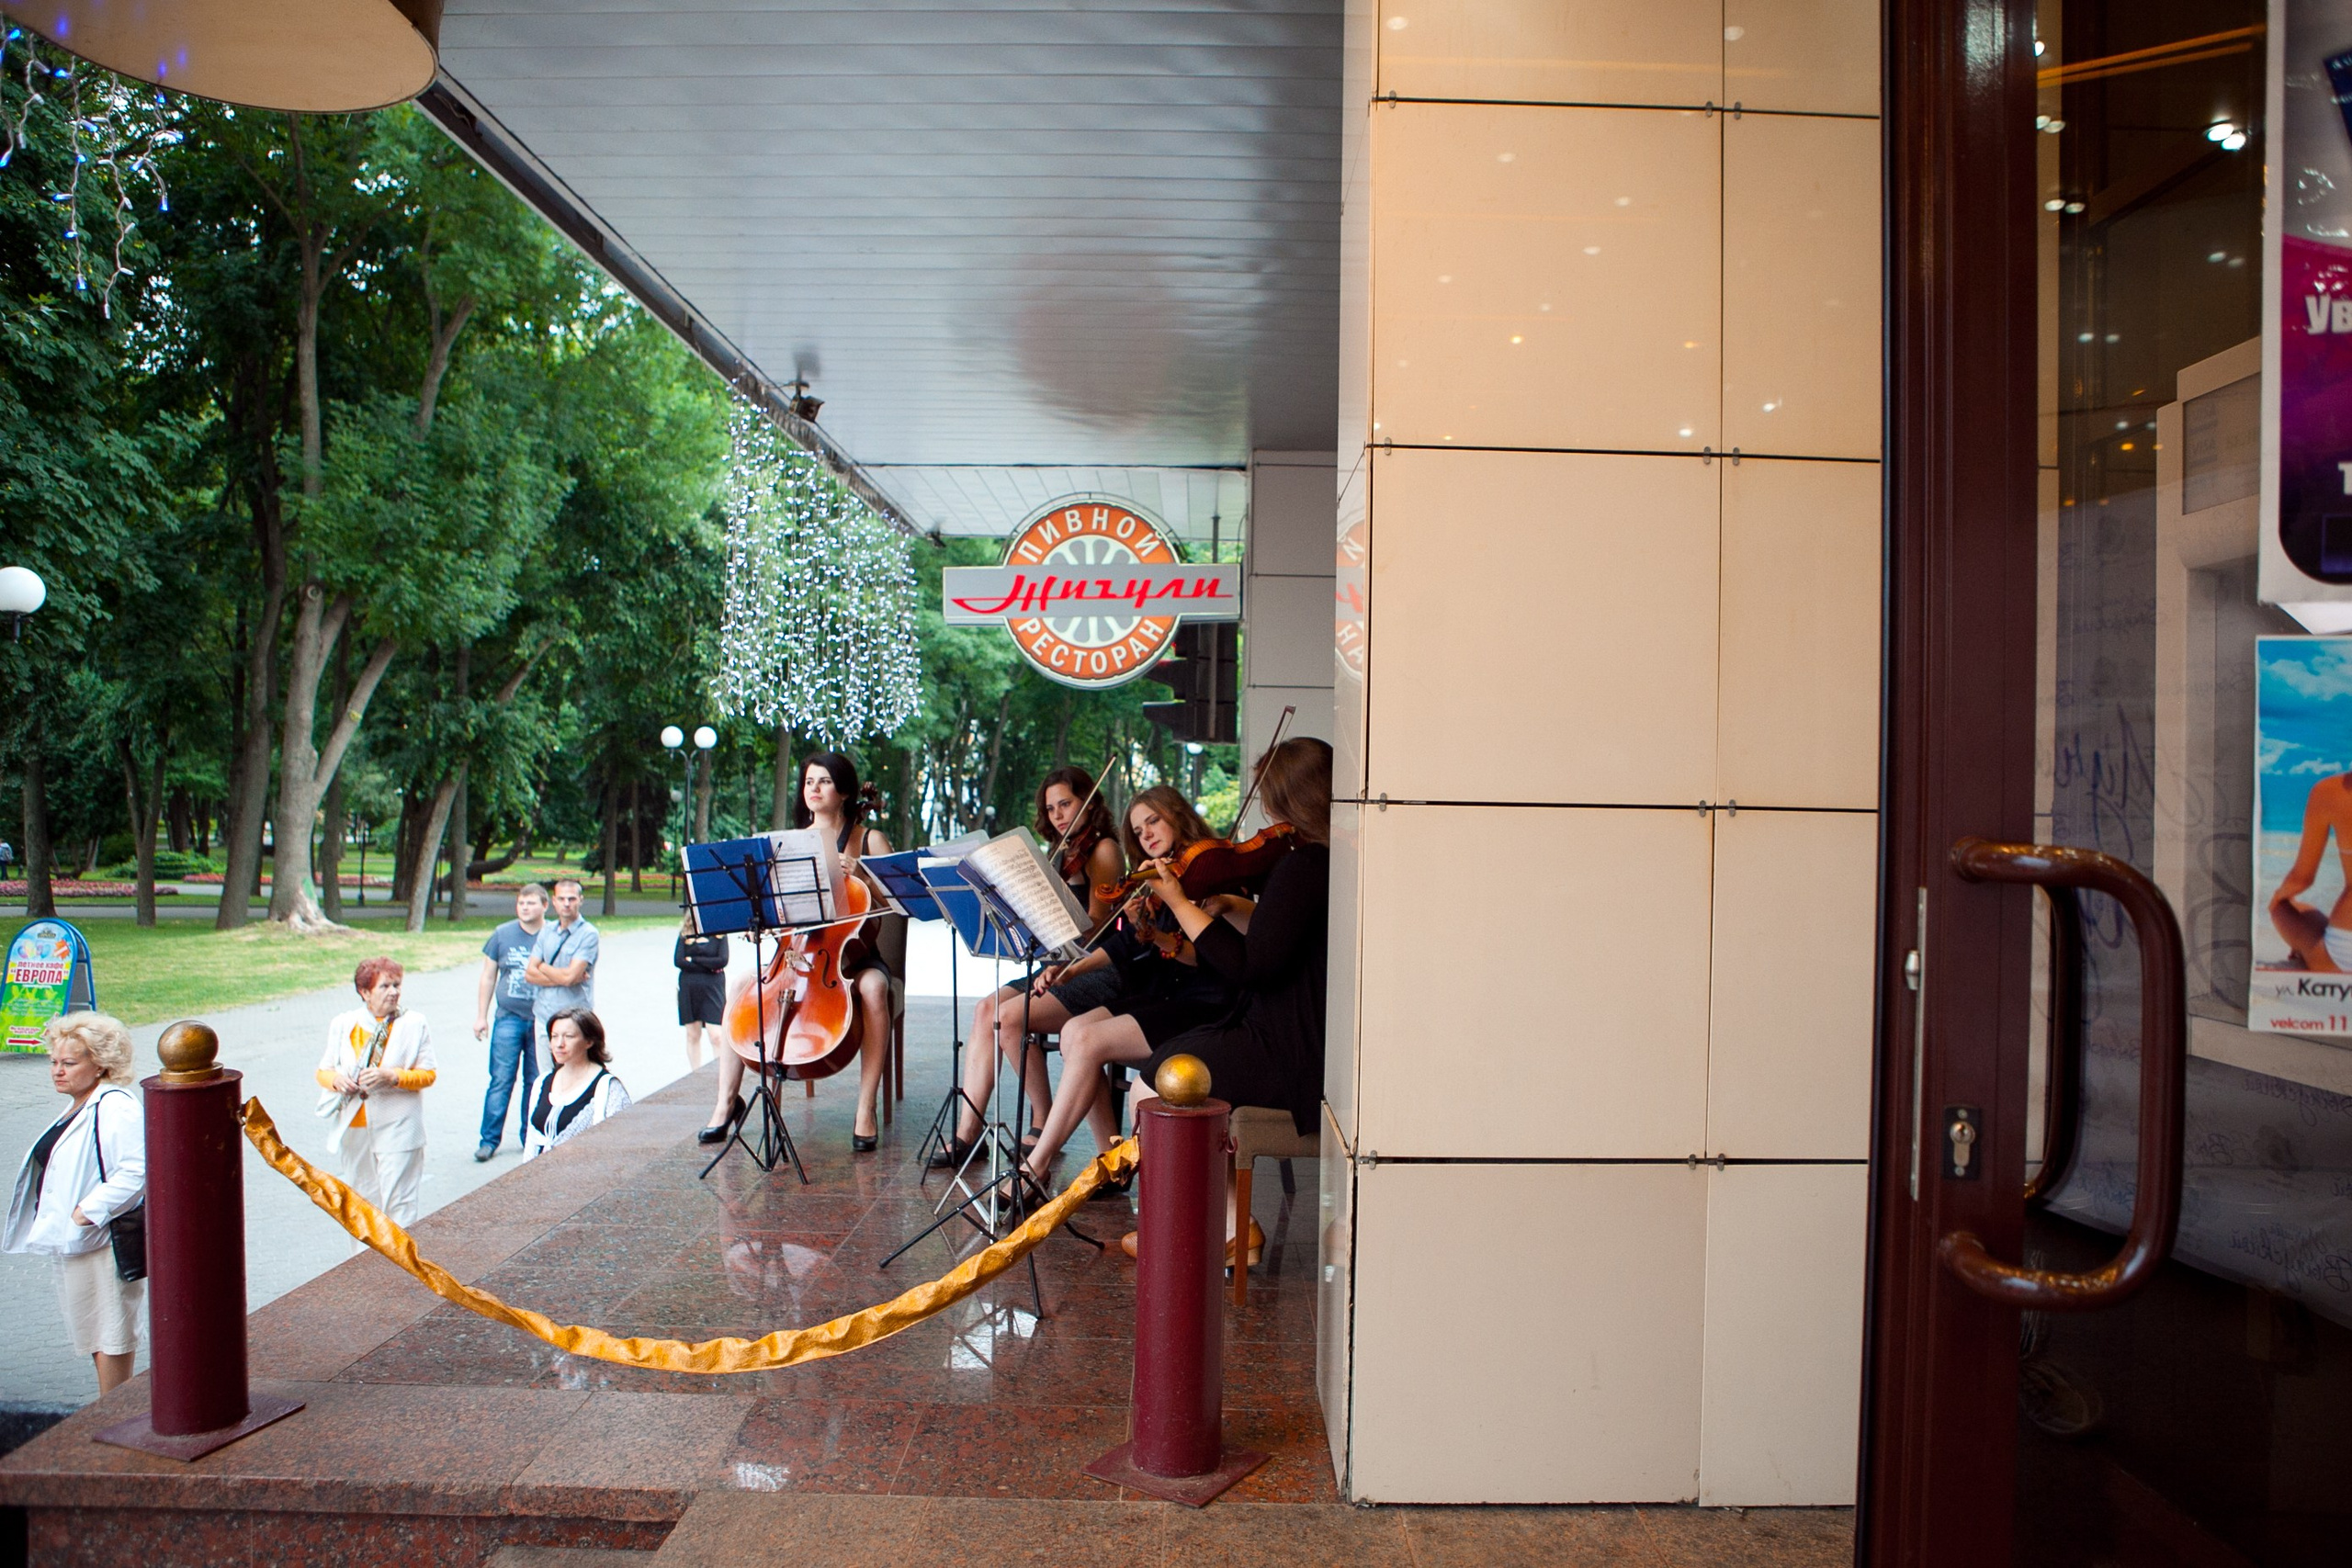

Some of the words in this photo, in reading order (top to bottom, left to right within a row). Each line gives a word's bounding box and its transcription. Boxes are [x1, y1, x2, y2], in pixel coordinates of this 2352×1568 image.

[1017, 507, 1162, 564] ПИВНОЙ
[950, 574, 1234, 615] Жигули
[1017, 619, 1164, 674] РЕСТОРАН
[46, 962, 64, 970] кафе
[2298, 977, 2352, 1002] Кату
[2270, 1017, 2324, 1030] velcom
